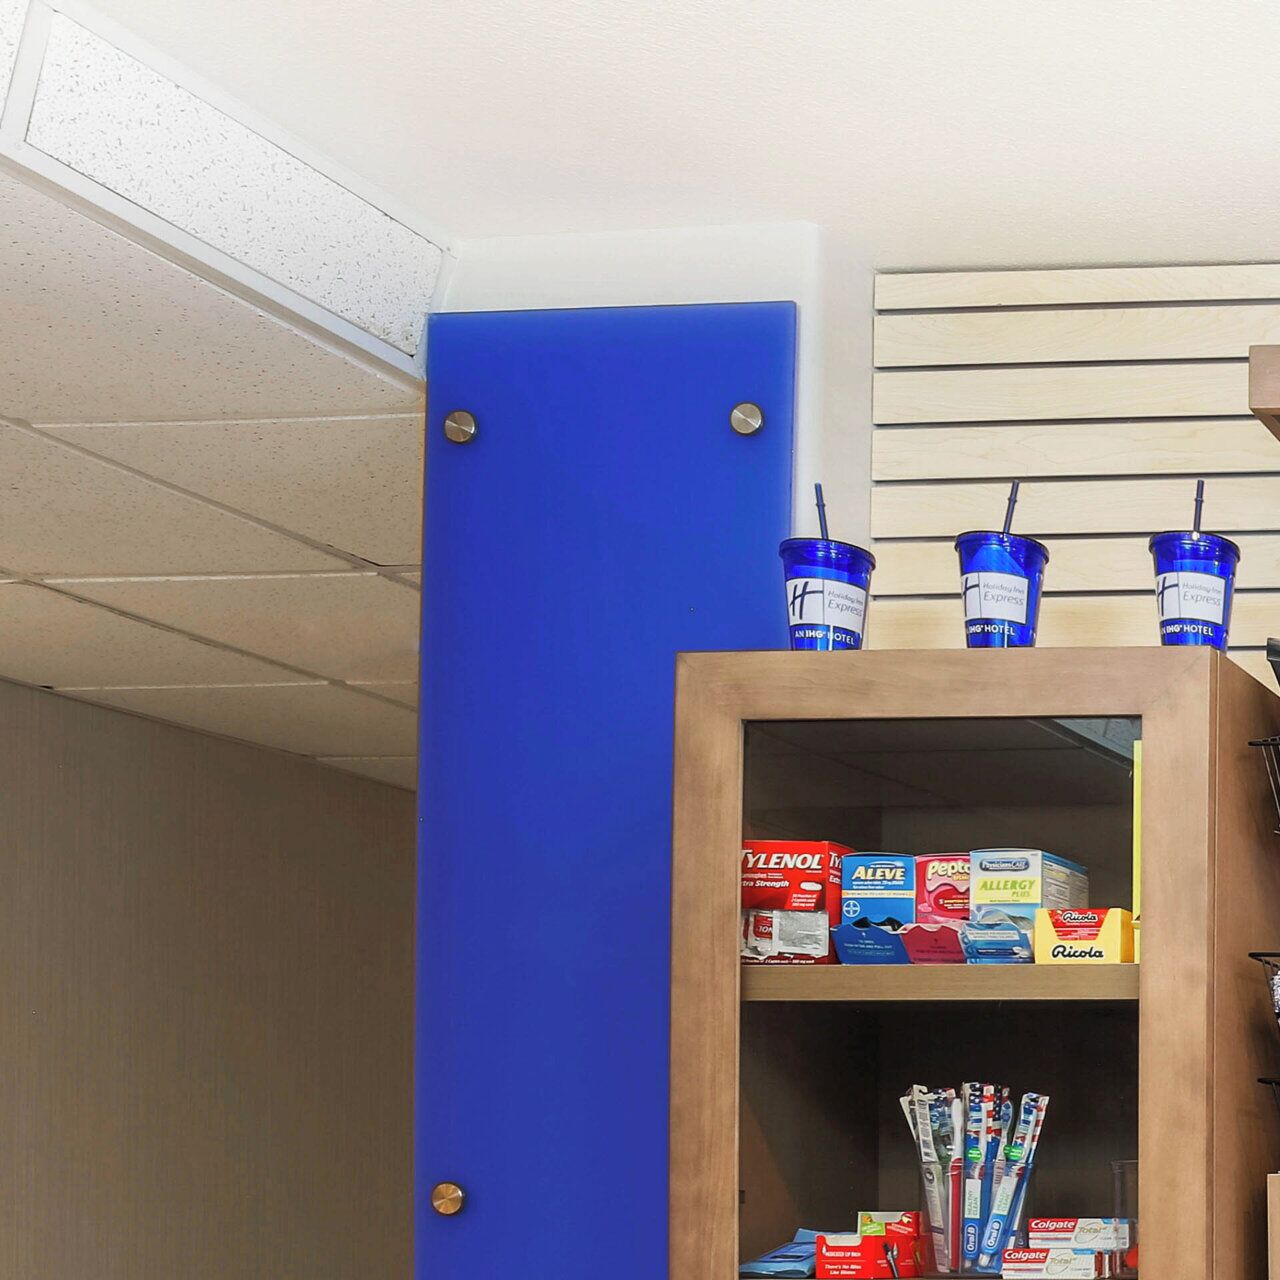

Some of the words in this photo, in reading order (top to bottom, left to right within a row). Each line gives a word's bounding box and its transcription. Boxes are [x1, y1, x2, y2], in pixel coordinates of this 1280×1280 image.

[982, 590, 1025, 607] Express
[1183, 592, 1222, 607] Express
[827, 600, 863, 617] Express
[984, 624, 1015, 636] HOTEL
[1182, 624, 1214, 636] HOTEL
[827, 630, 855, 645] HOTEL
[852, 866, 906, 880] ALEVE
[755, 880, 790, 888] Strength
[979, 879, 1036, 891] ALLERGY
[1062, 911, 1099, 921] Ricola
[1052, 944, 1104, 958] Ricola
[1031, 1220, 1077, 1231] Colgate
[1004, 1251, 1048, 1262] Colgate
